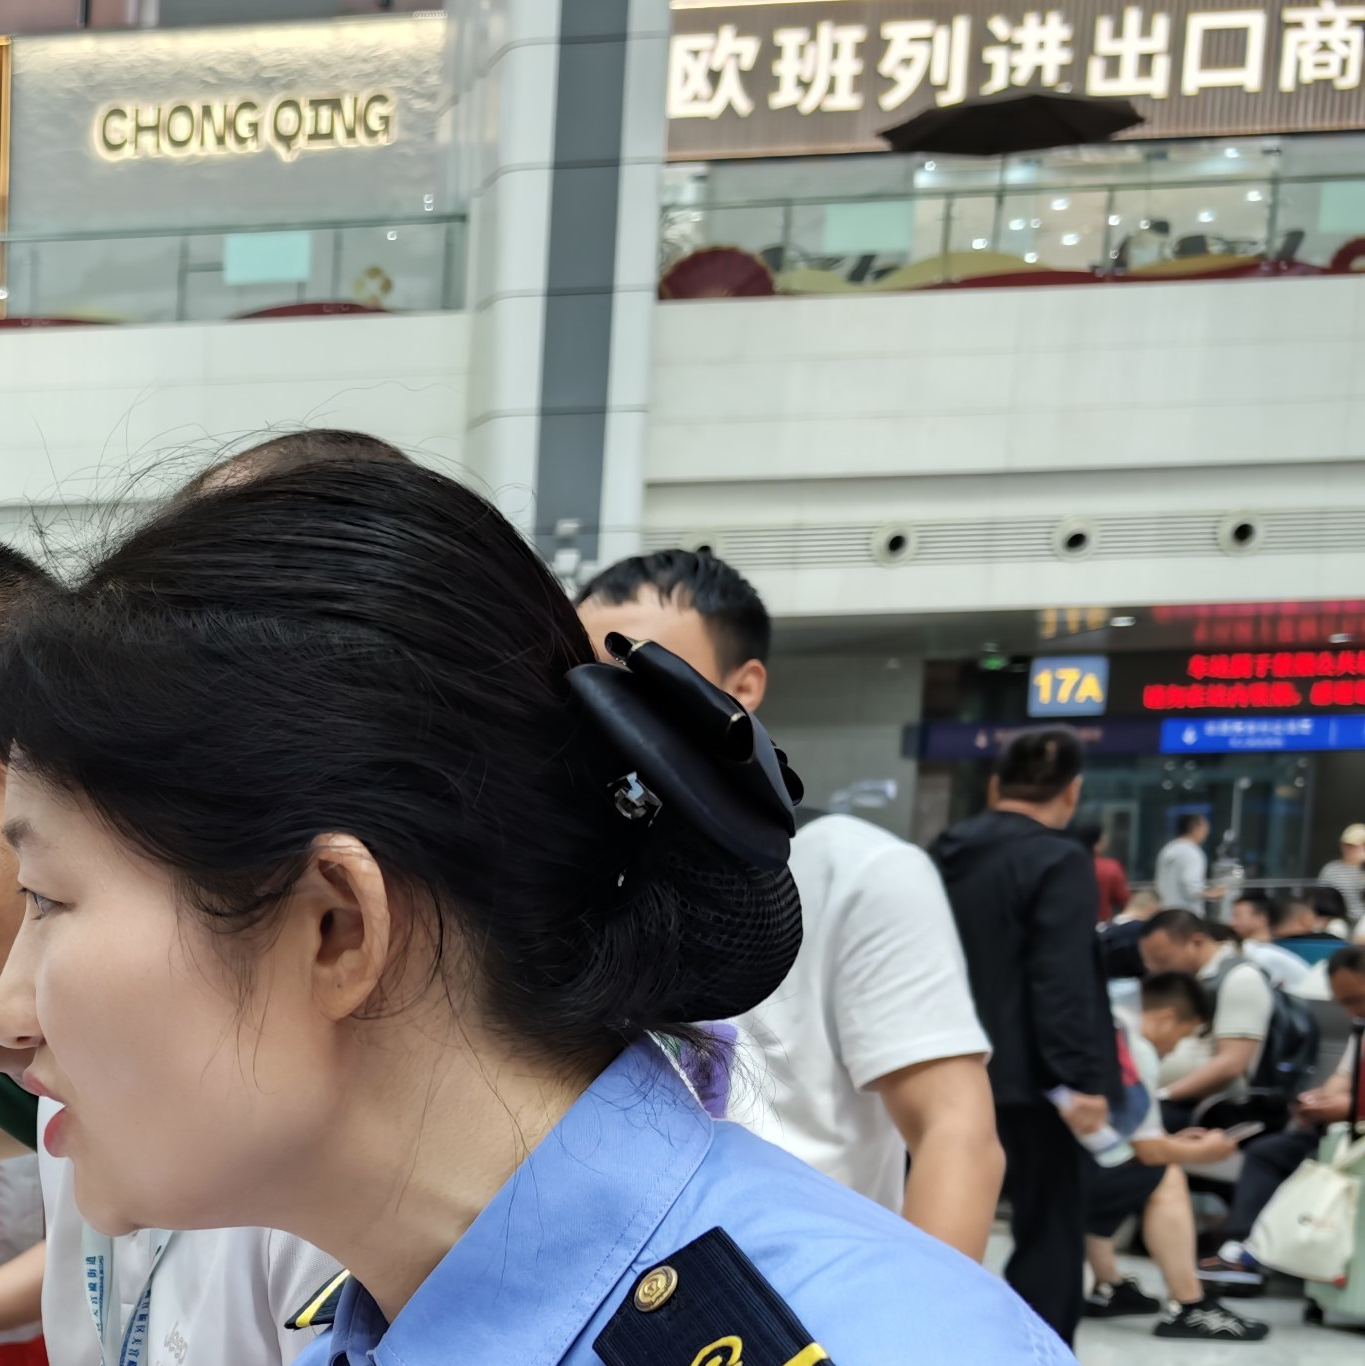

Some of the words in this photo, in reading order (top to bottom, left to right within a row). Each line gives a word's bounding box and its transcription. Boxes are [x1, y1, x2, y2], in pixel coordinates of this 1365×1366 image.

[98, 101, 259, 161] CHONG
[272, 93, 395, 161] QING
[1032, 667, 1103, 706] 17A
